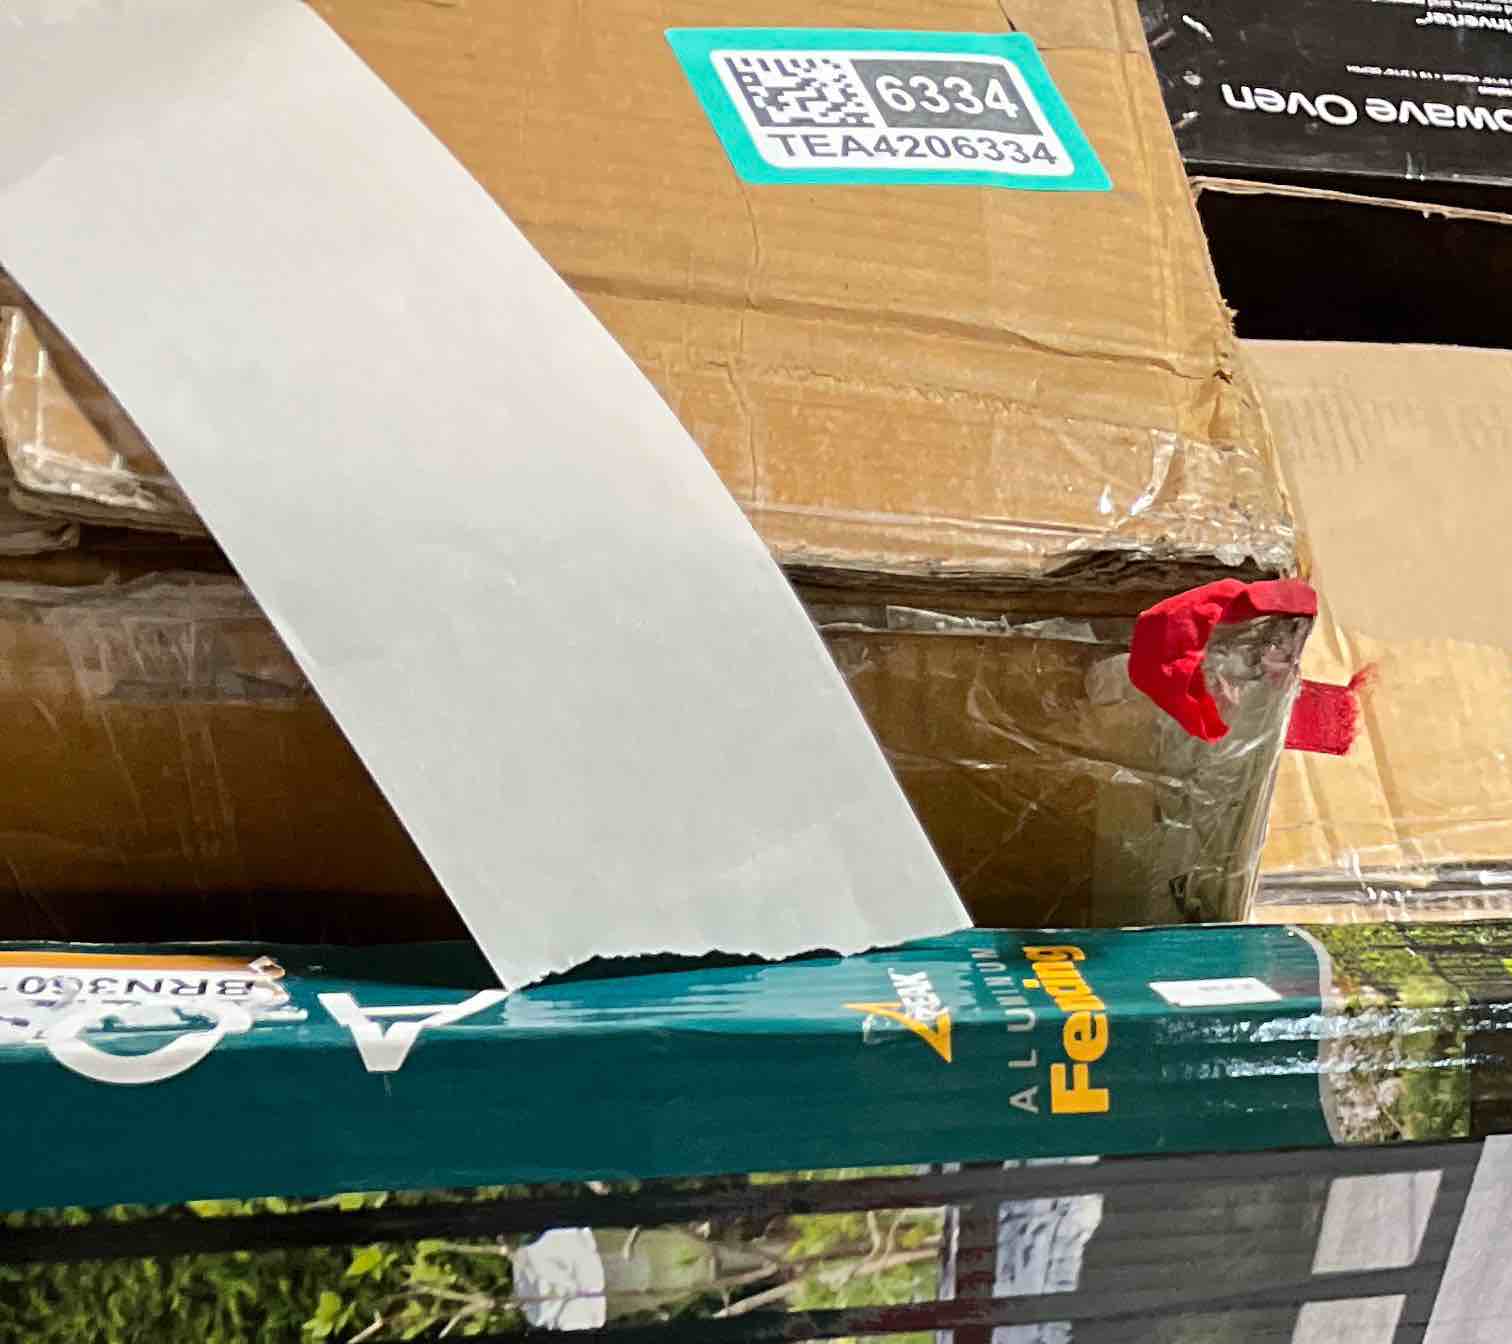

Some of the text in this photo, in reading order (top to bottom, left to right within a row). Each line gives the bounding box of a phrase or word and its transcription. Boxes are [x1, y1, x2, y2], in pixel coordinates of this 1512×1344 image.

[876, 75, 1019, 119] 6334
[1220, 82, 1358, 127] Oven
[768, 133, 1057, 166] TEA4206334
